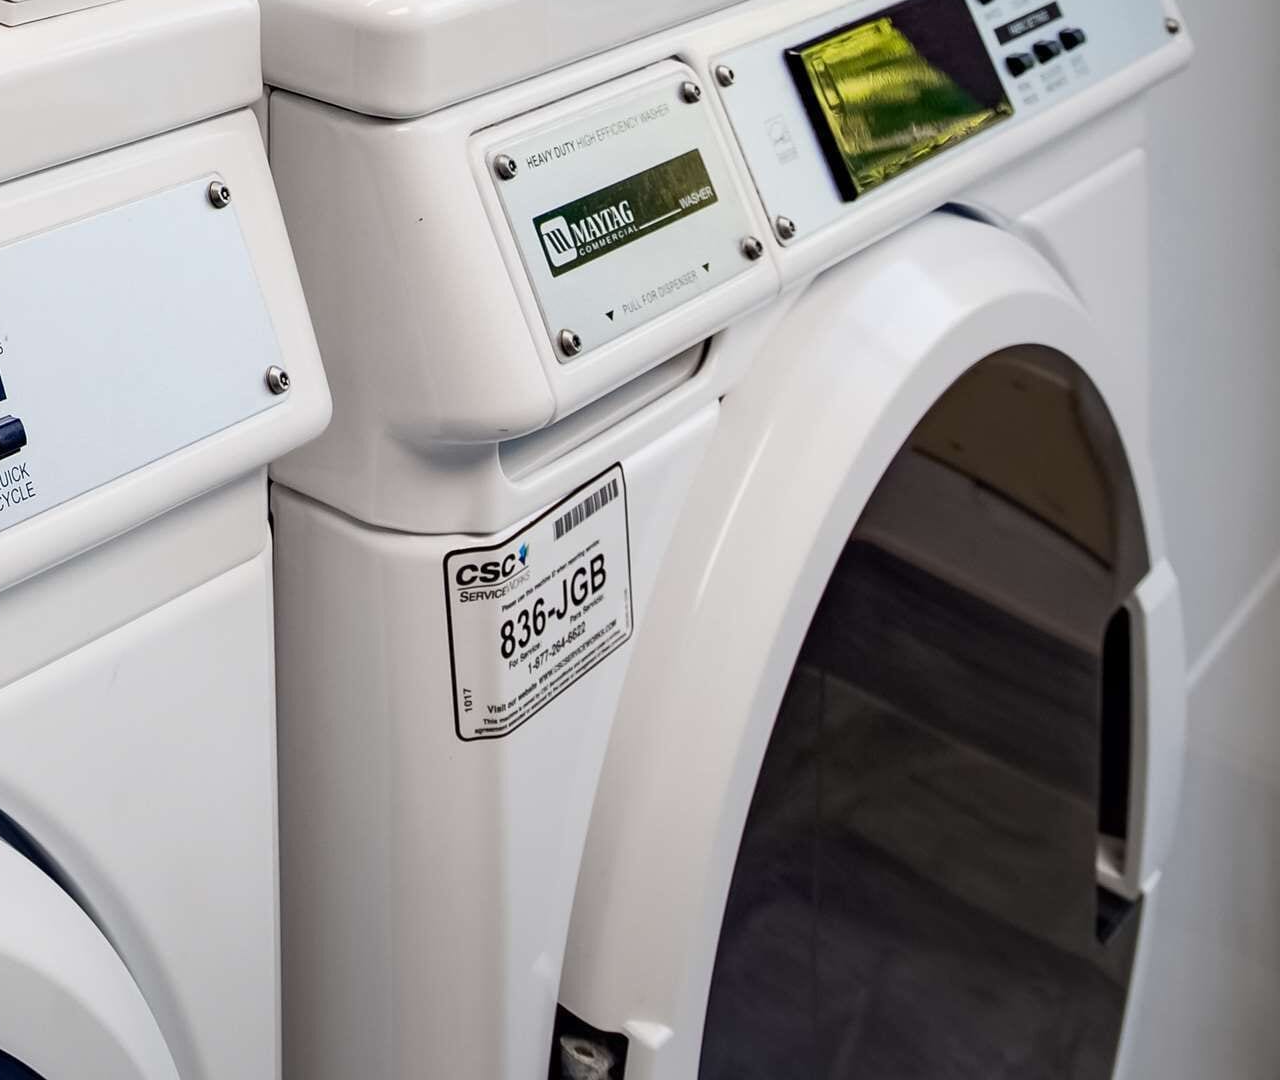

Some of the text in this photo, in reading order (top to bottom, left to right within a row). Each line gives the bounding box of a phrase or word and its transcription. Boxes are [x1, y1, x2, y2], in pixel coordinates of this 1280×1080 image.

[526, 103, 670, 170] HEAVY DUTY HIGH EFFICIENCY WASHER
[678, 185, 715, 210] WASHER
[570, 199, 635, 247] MAYTAG
[578, 223, 640, 257] COMMERCIAL
[622, 270, 698, 314] PULL FOR DISPENSER
[455, 553, 516, 586] CSC
[500, 553, 607, 660] 836-JGB
[462, 687, 473, 713] 1017
[486, 702, 507, 714] Visit
